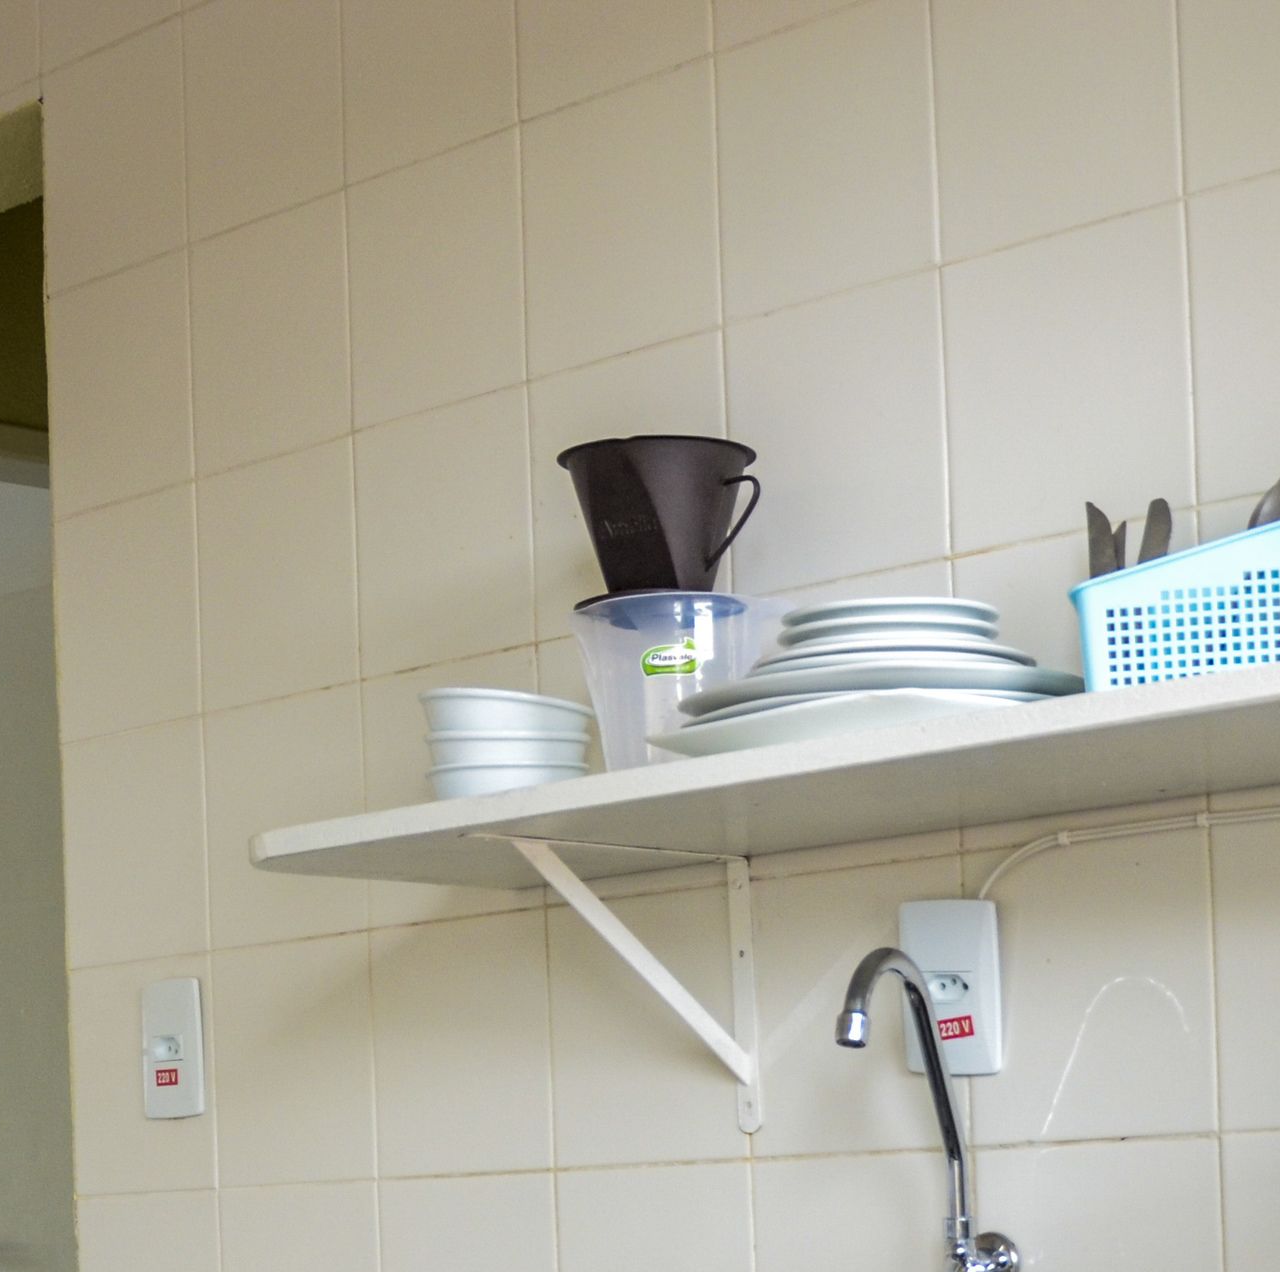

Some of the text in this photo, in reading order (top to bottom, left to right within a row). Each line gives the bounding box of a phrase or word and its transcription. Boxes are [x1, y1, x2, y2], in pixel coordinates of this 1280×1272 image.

[940, 1020, 970, 1037] 220 V
[157, 1071, 176, 1084] 220 V
